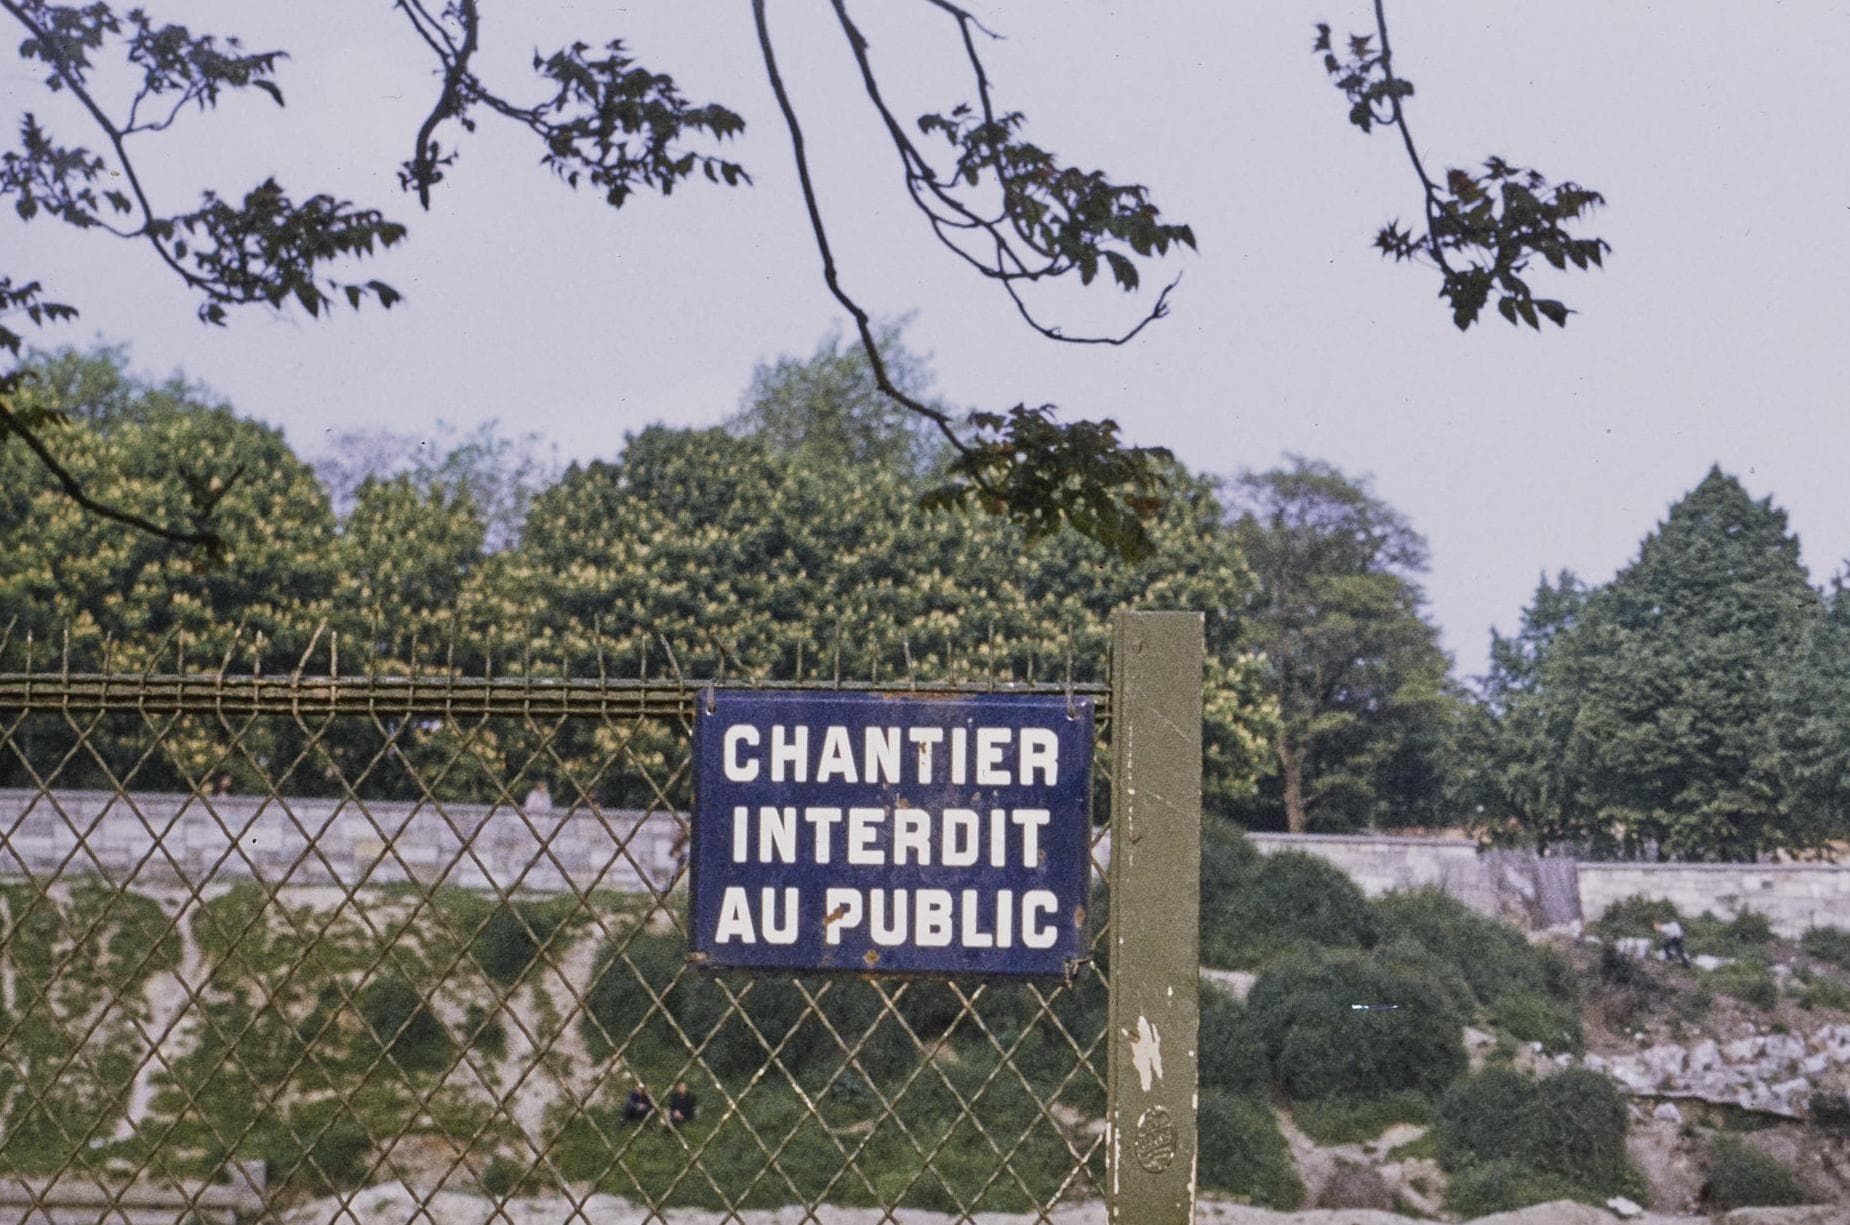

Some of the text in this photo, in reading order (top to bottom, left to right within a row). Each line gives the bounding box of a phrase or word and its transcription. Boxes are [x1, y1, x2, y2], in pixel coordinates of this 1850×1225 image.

[722, 724, 1060, 787] CHANTIER
[731, 806, 1052, 868] INTERDIT
[714, 886, 1060, 949] AU PUBLIC
